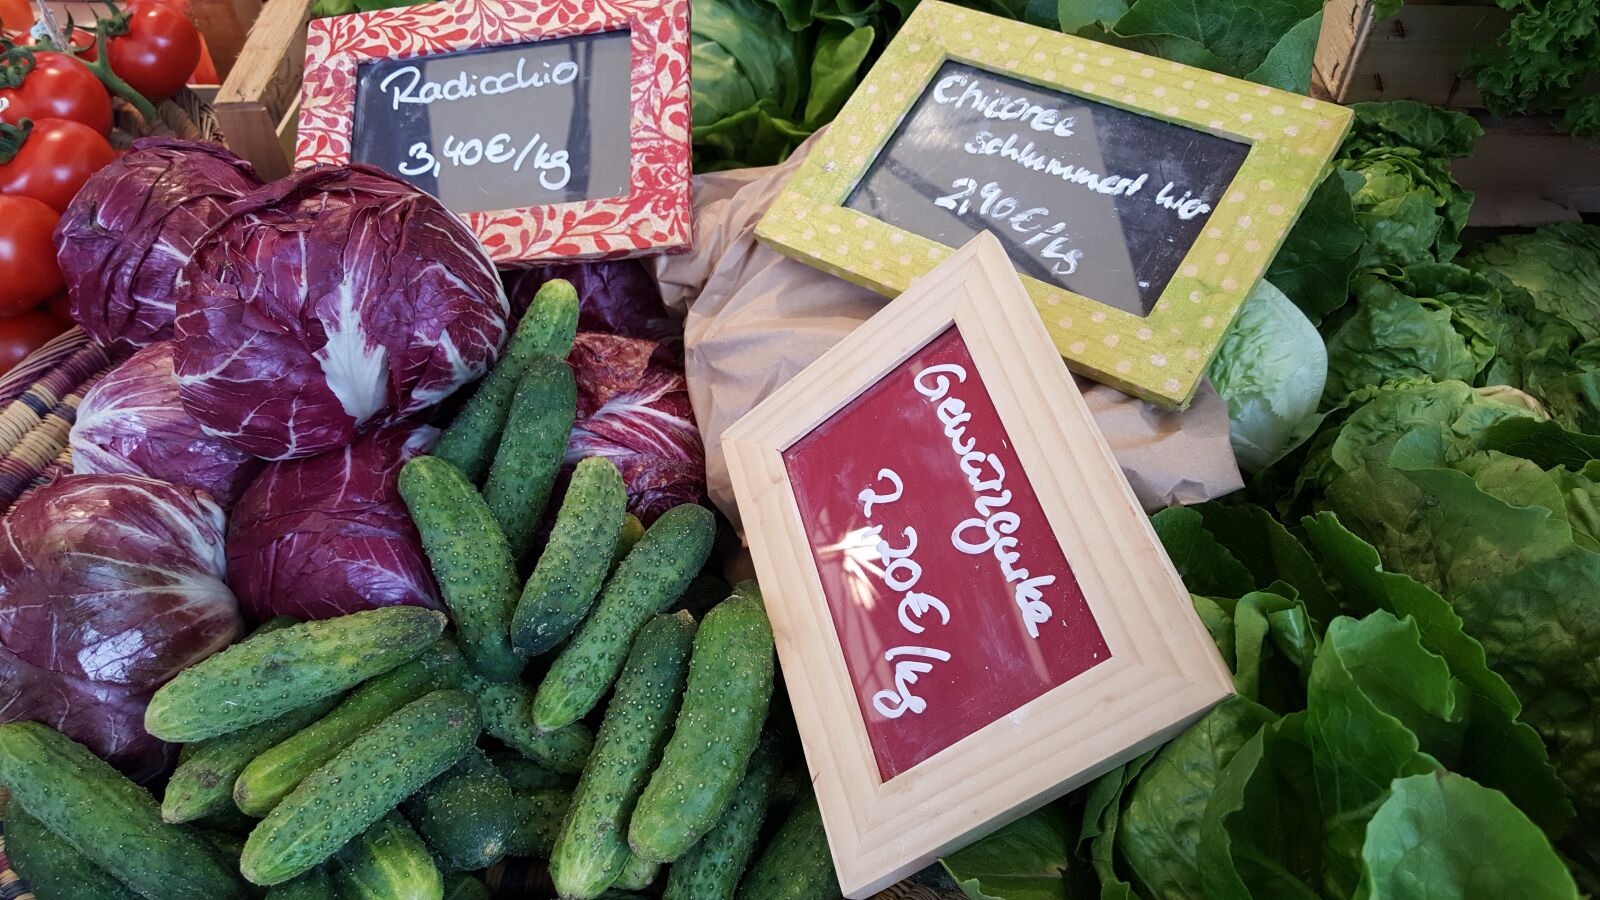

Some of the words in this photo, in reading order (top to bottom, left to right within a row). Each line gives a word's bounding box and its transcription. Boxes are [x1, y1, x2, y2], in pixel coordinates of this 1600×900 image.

[380, 57, 578, 110] Radicchio
[933, 74, 1077, 137] Chicoree
[398, 133, 571, 190] 3,40€/kg
[913, 363, 1056, 638] Gewürzgurke
